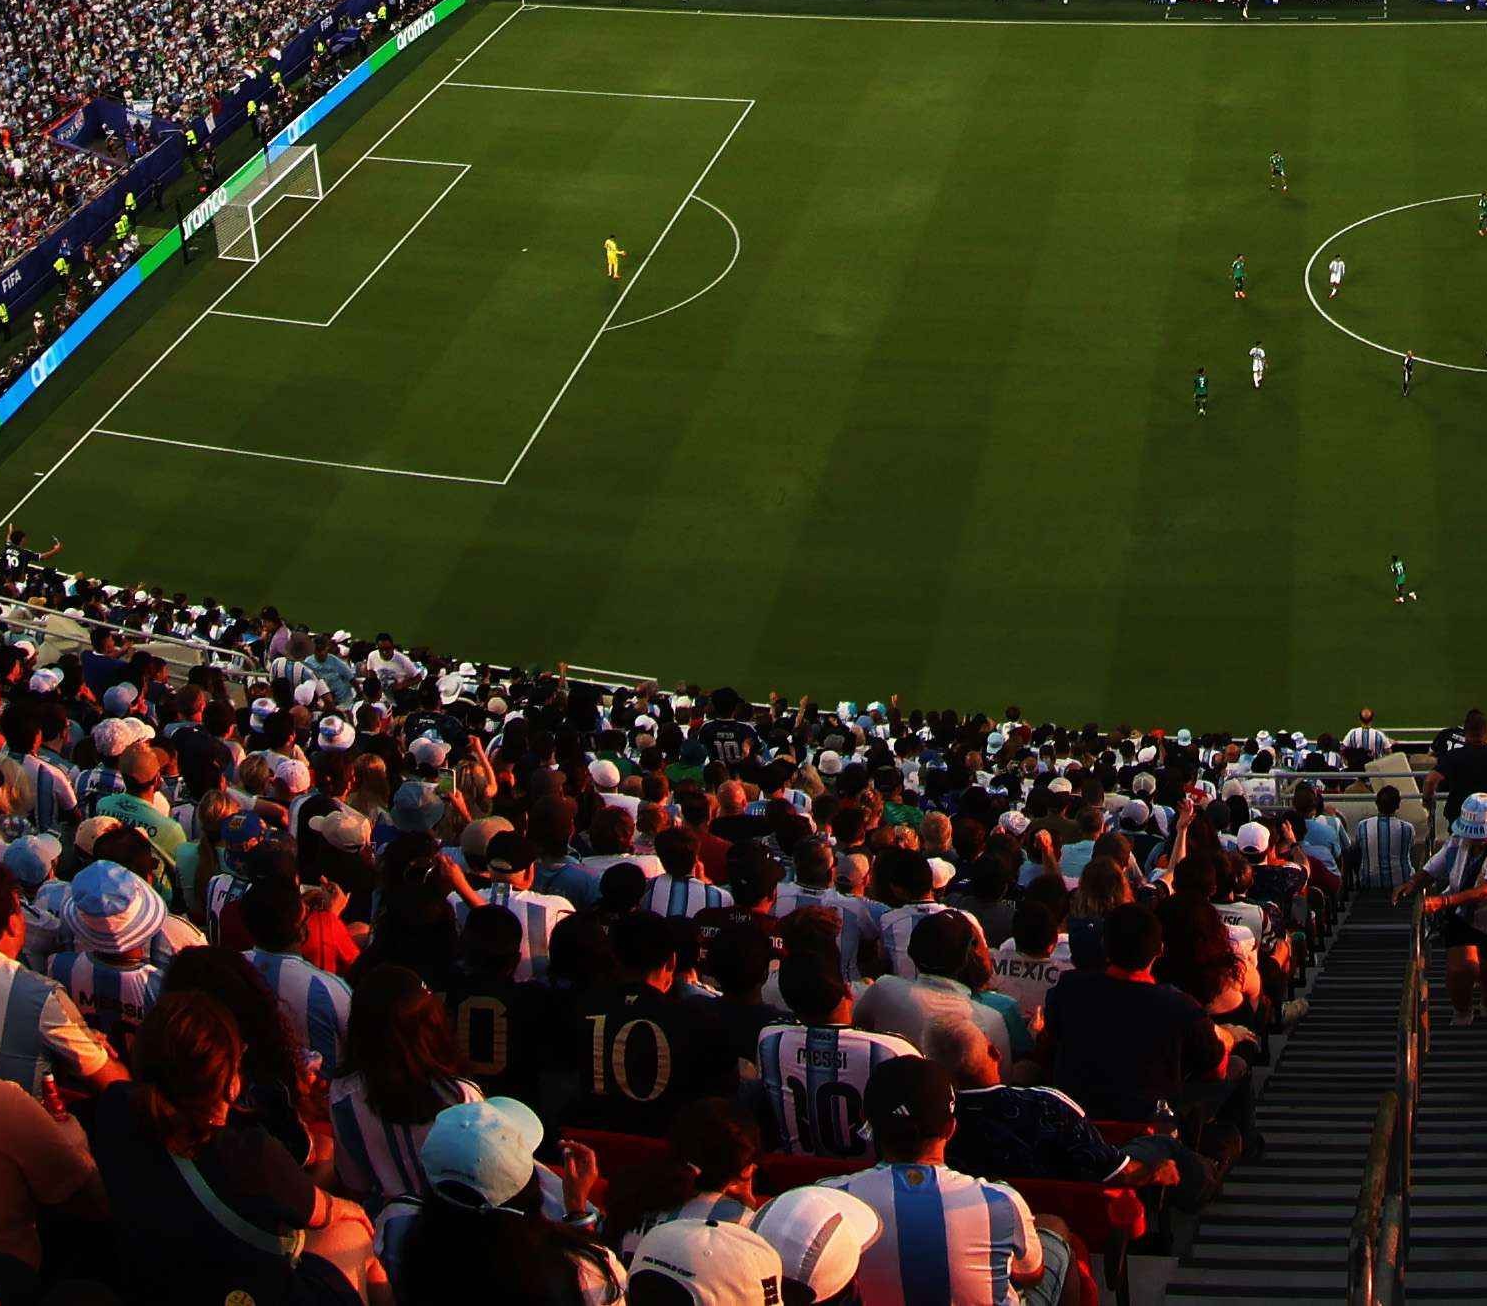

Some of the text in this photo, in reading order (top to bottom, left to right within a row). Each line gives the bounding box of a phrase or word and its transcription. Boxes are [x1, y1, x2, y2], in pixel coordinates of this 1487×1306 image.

[396, 11, 436, 51] aramco
[2, 269, 23, 294] FIFA
[713, 741, 740, 763] 10
[992, 958, 1060, 985] MEXIC
[584, 1013, 673, 1102] 10
[797, 1048, 848, 1070] MESSI
